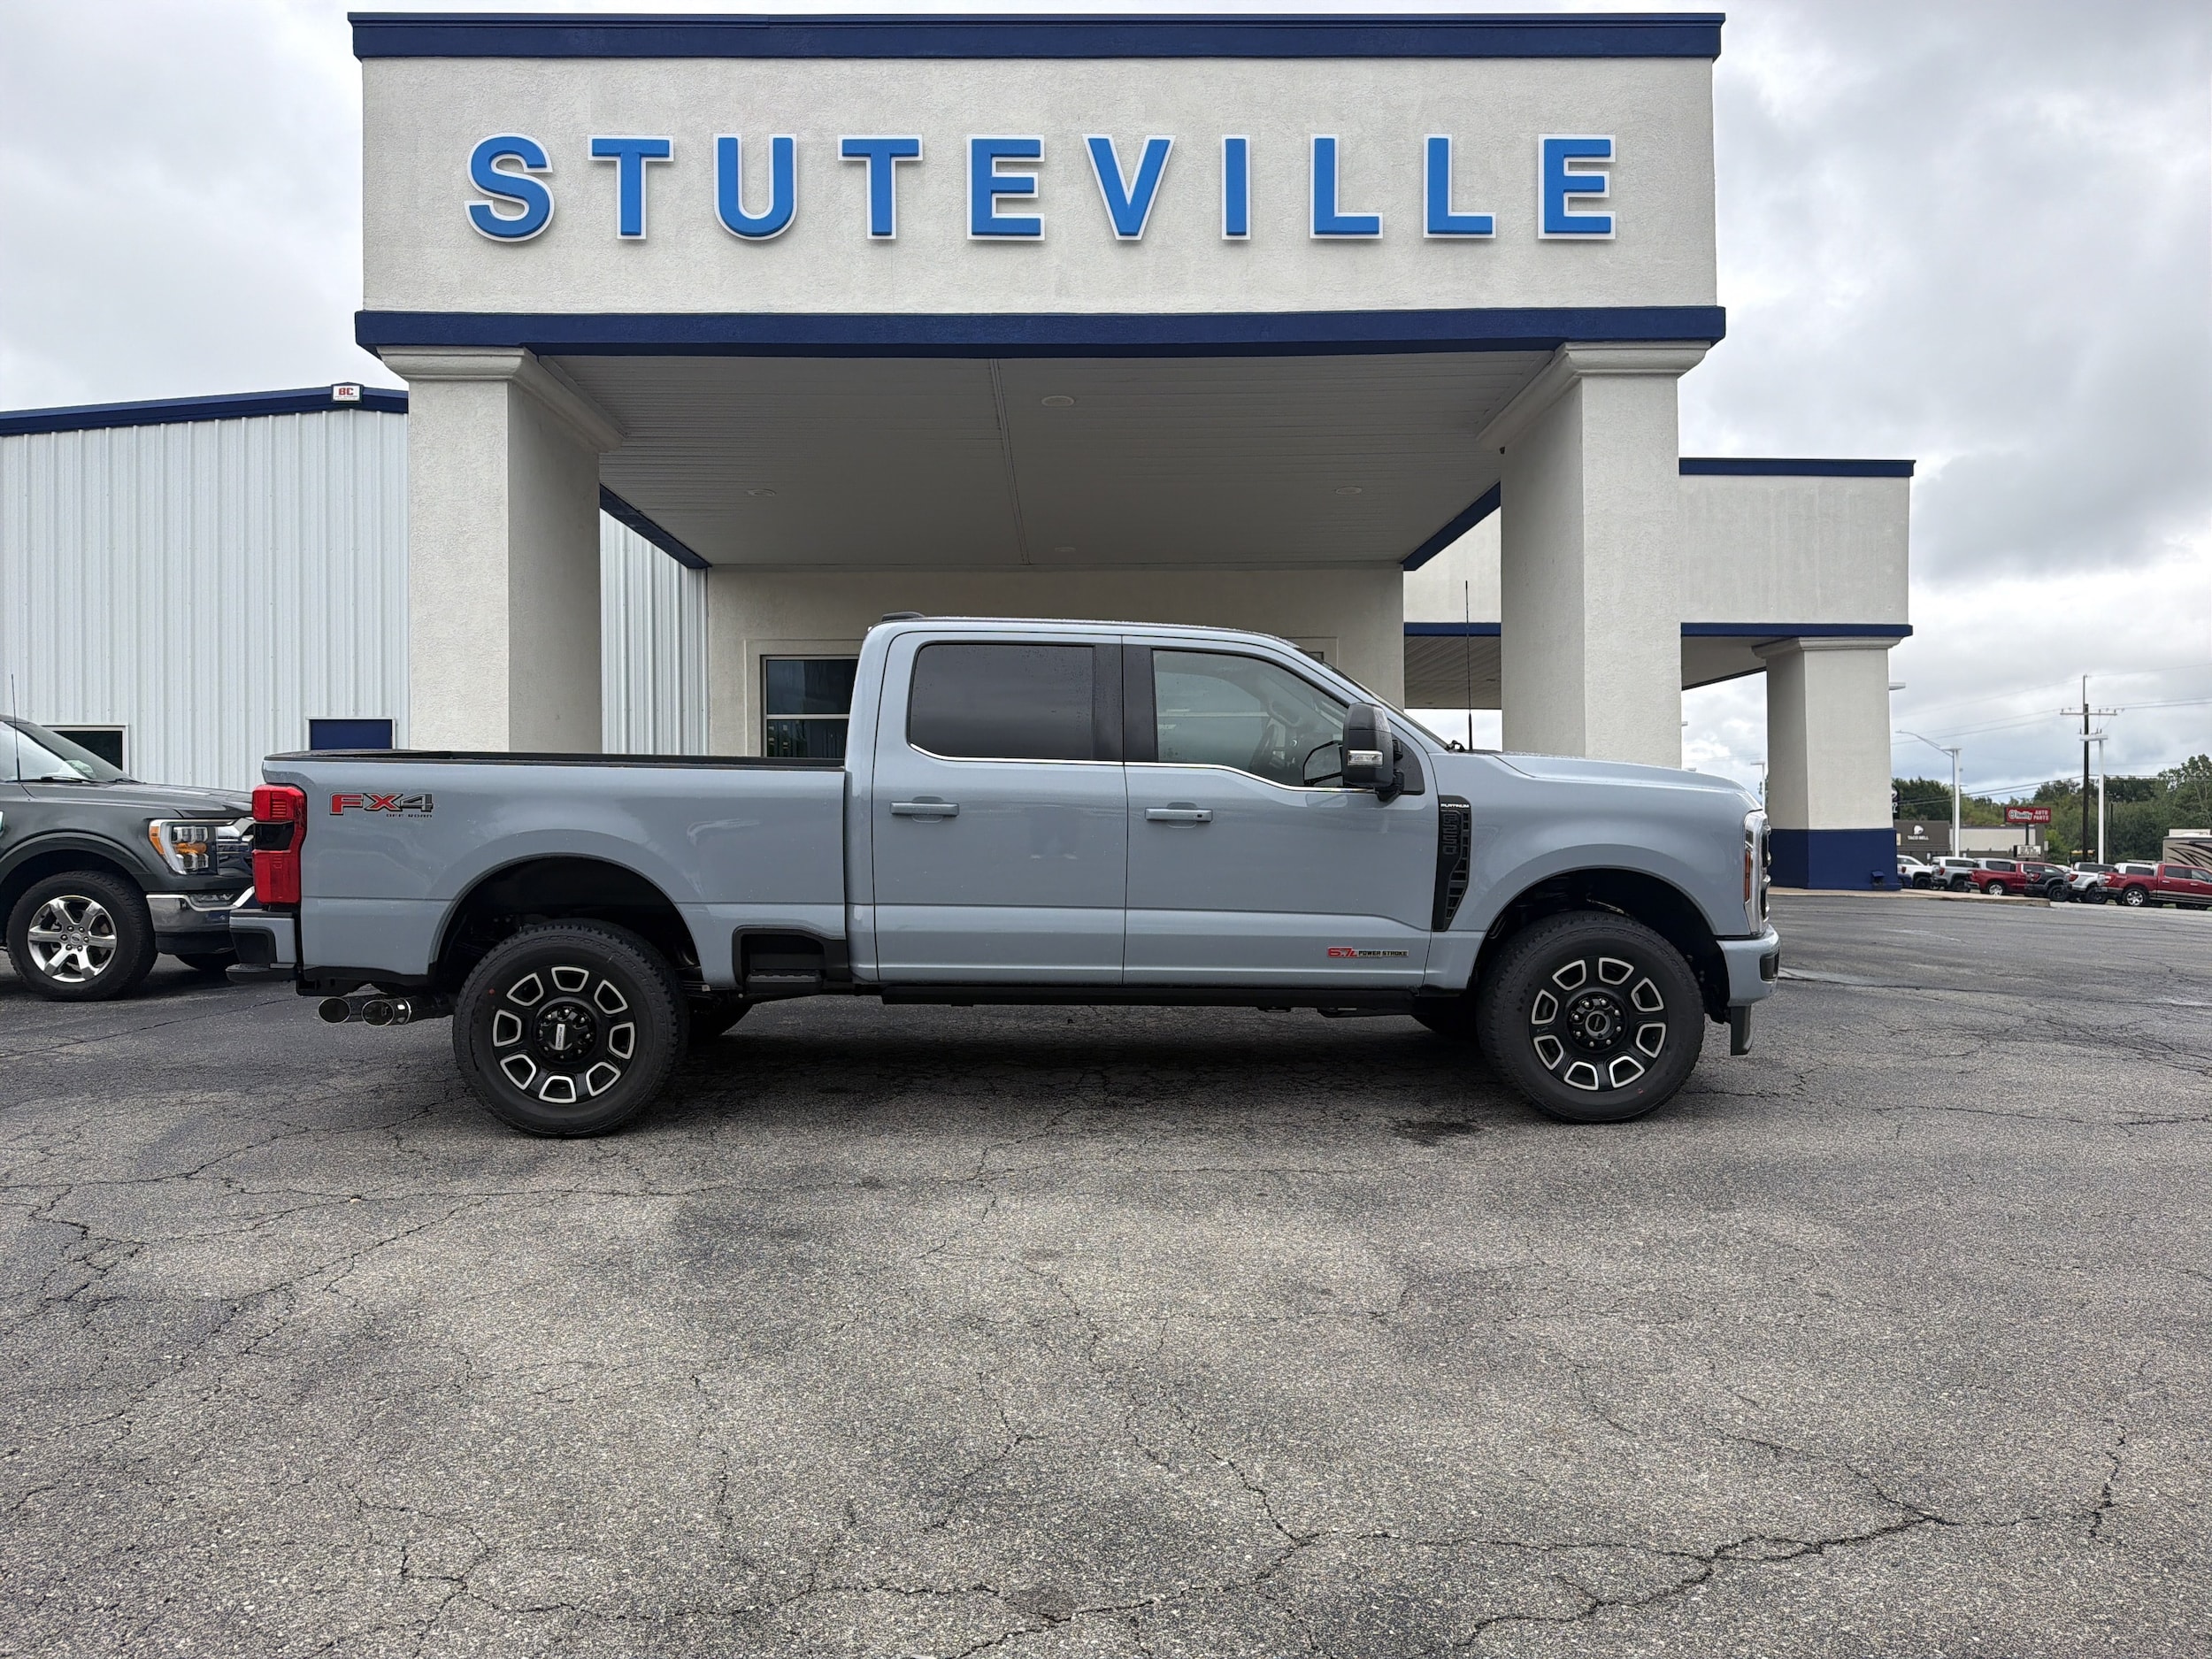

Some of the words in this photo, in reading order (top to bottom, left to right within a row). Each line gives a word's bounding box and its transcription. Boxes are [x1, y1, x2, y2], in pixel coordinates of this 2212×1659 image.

[465, 134, 1617, 242] STUTEVILLE
[329, 792, 434, 815] FX4
[1328, 947, 1358, 957] 6.7L
